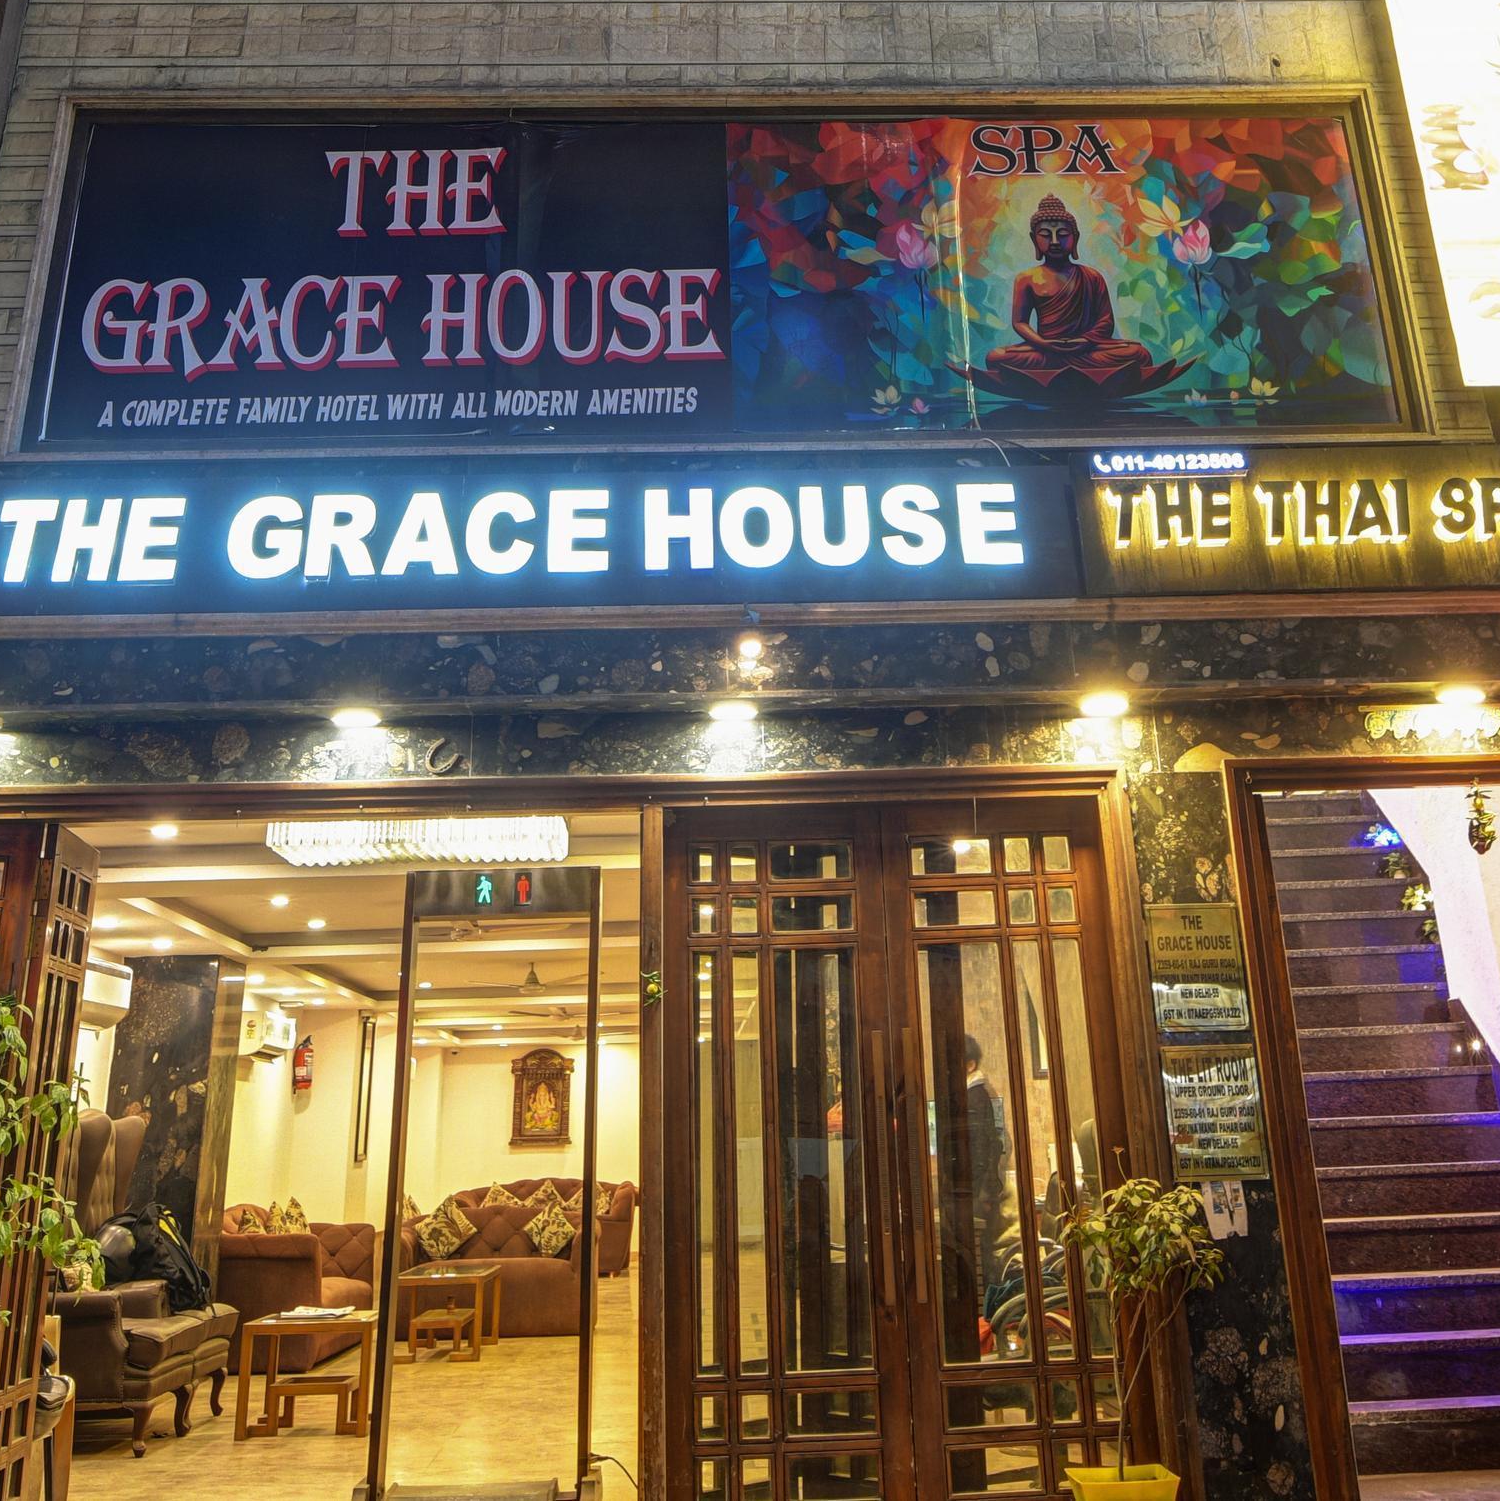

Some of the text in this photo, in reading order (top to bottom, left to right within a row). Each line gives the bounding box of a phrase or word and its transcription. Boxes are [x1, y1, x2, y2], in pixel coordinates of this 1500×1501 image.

[967, 124, 1122, 176] SPA
[325, 147, 509, 237] THE
[82, 268, 727, 382] GRACE HOUSE
[97, 387, 698, 428] A COMPLETE FAMILY HOTEL WITH ALL MODERN AMENITIES
[1104, 482, 1233, 549] THE
[1254, 477, 1411, 547] THAI
[226, 489, 610, 580] GRACE
[643, 483, 1026, 573] HOUSE
[1181, 915, 1203, 931] THE
[1157, 935, 1232, 952] GRACE HOUSE
[1180, 988, 1193, 999] NEW
[1216, 1055, 1249, 1082] ROOM
[1174, 1084, 1249, 1098] UPPER GROUND FLOOR
[1206, 1107, 1219, 1118] RAJ
[1239, 1106, 1255, 1117] ROAD
